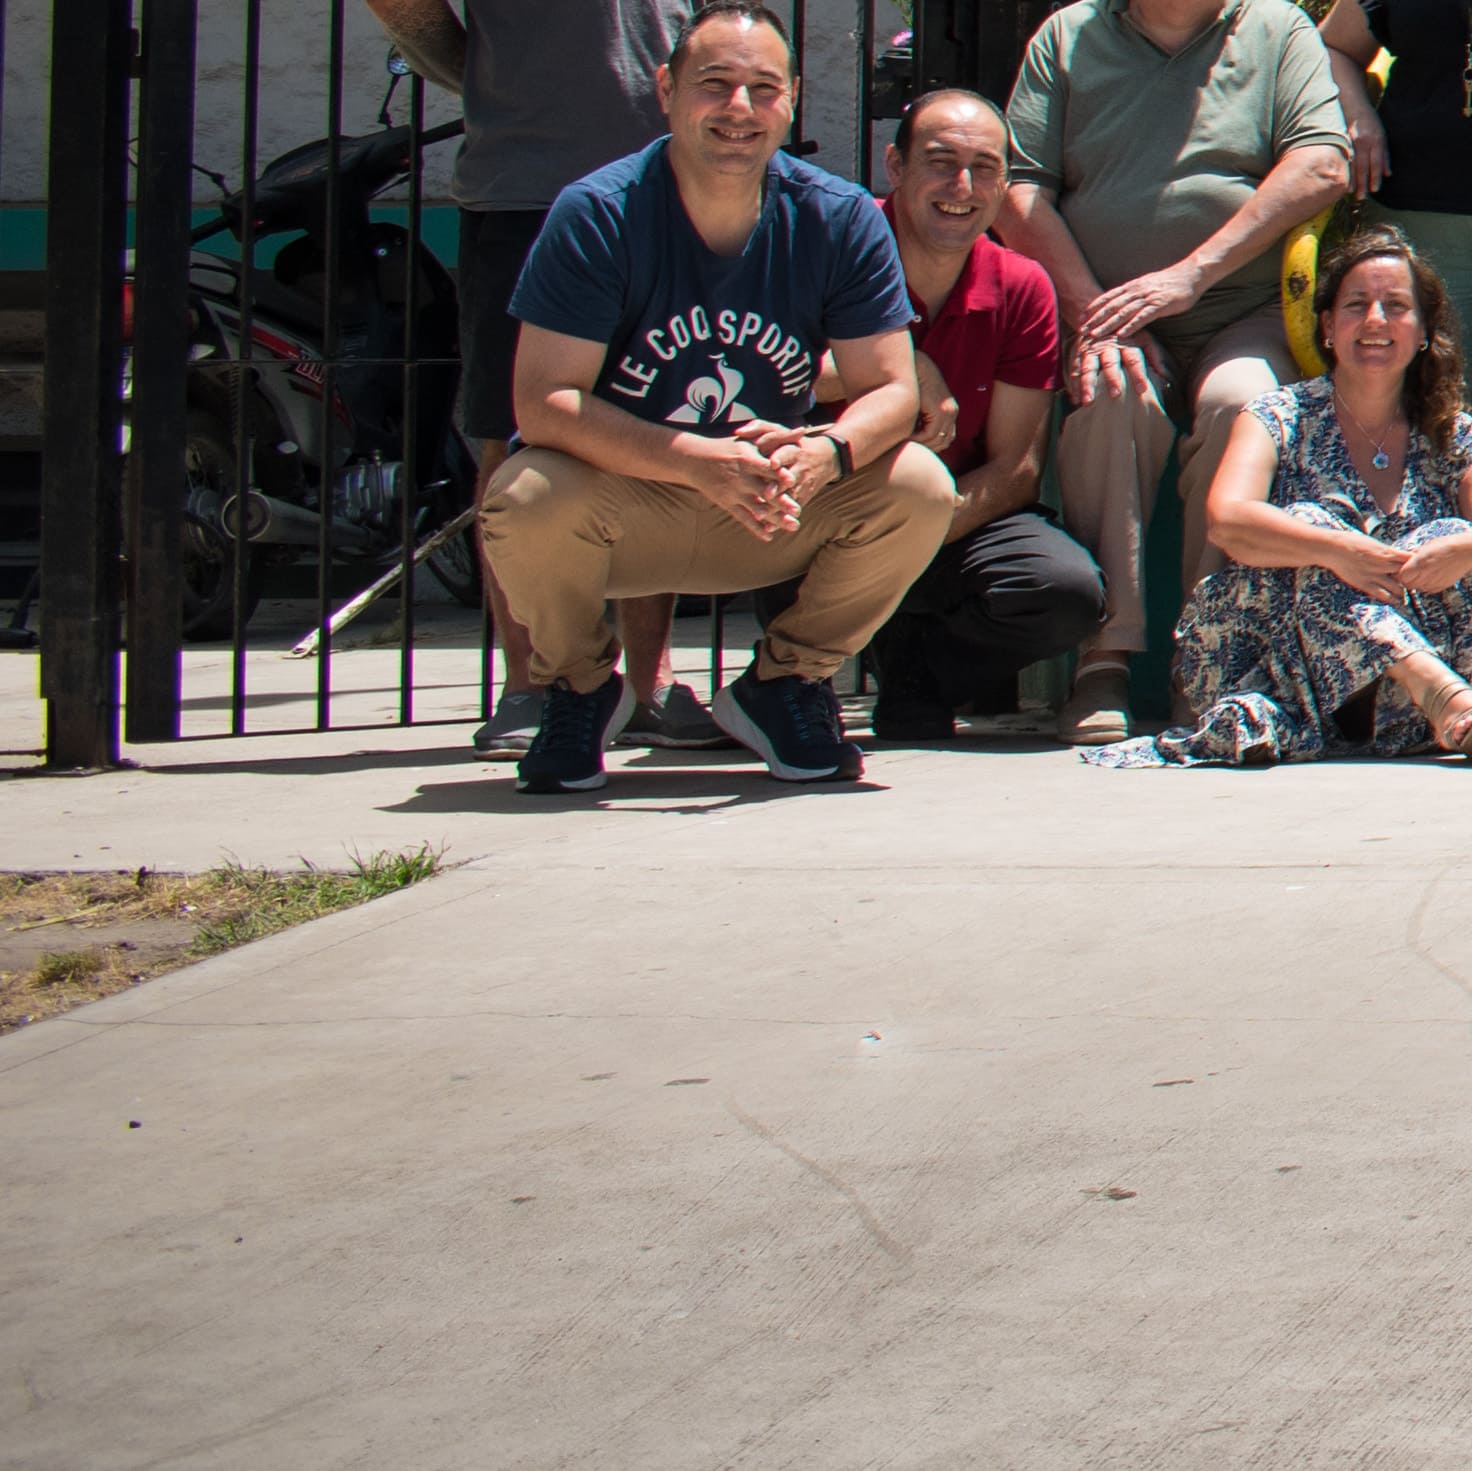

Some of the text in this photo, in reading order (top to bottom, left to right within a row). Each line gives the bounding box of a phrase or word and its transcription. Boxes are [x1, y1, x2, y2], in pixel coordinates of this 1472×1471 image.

[610, 304, 812, 399] LE COQ SPORTIF
